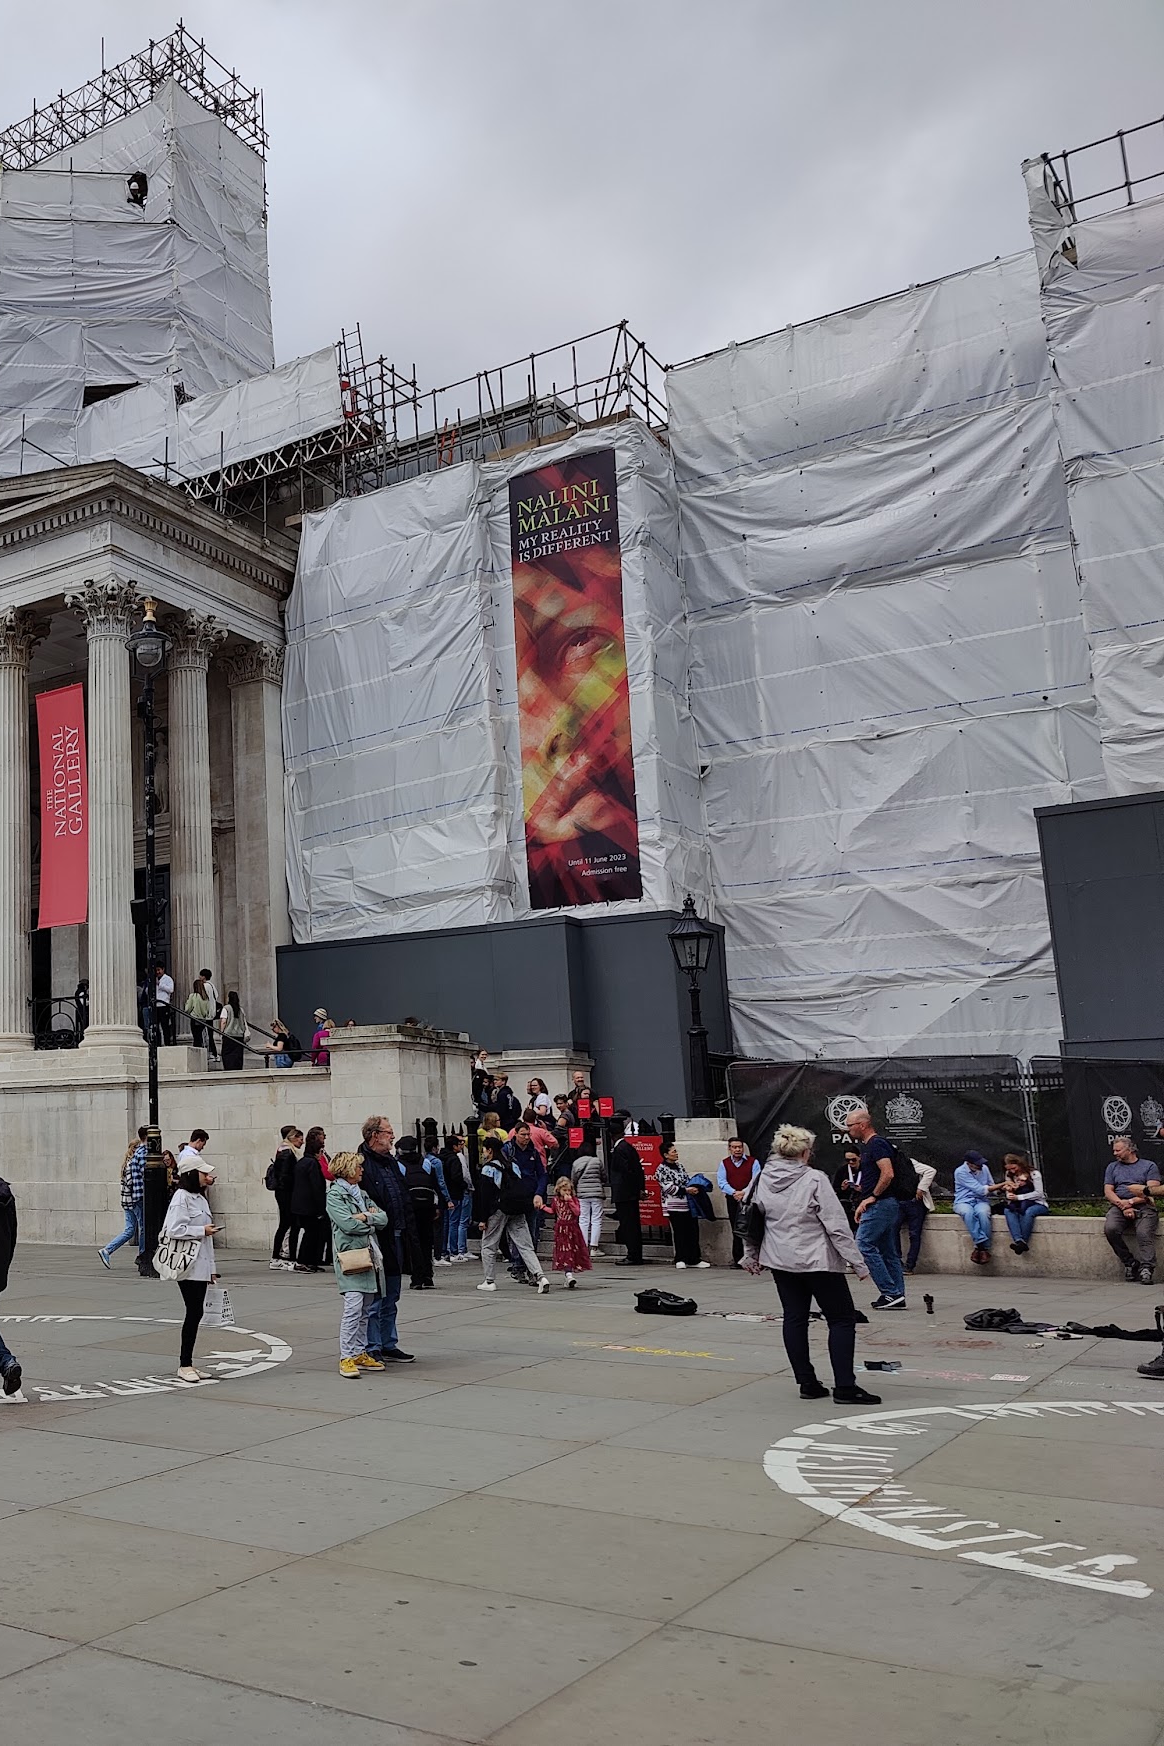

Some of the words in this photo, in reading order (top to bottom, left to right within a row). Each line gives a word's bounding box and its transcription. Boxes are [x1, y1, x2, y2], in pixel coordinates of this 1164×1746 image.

[517, 479, 599, 518] NALINI
[518, 494, 611, 536] MALANI
[518, 533, 539, 551] MY
[541, 518, 603, 543] REALITY
[518, 551, 531, 563] IS
[532, 529, 612, 559] DIFFERENT
[51, 726, 67, 838] NATIONAL
[64, 725, 82, 835] GALLERY
[568, 858, 583, 866] Until
[609, 853, 627, 862] 2023
[581, 868, 613, 876] Admission
[614, 865, 628, 873] free
